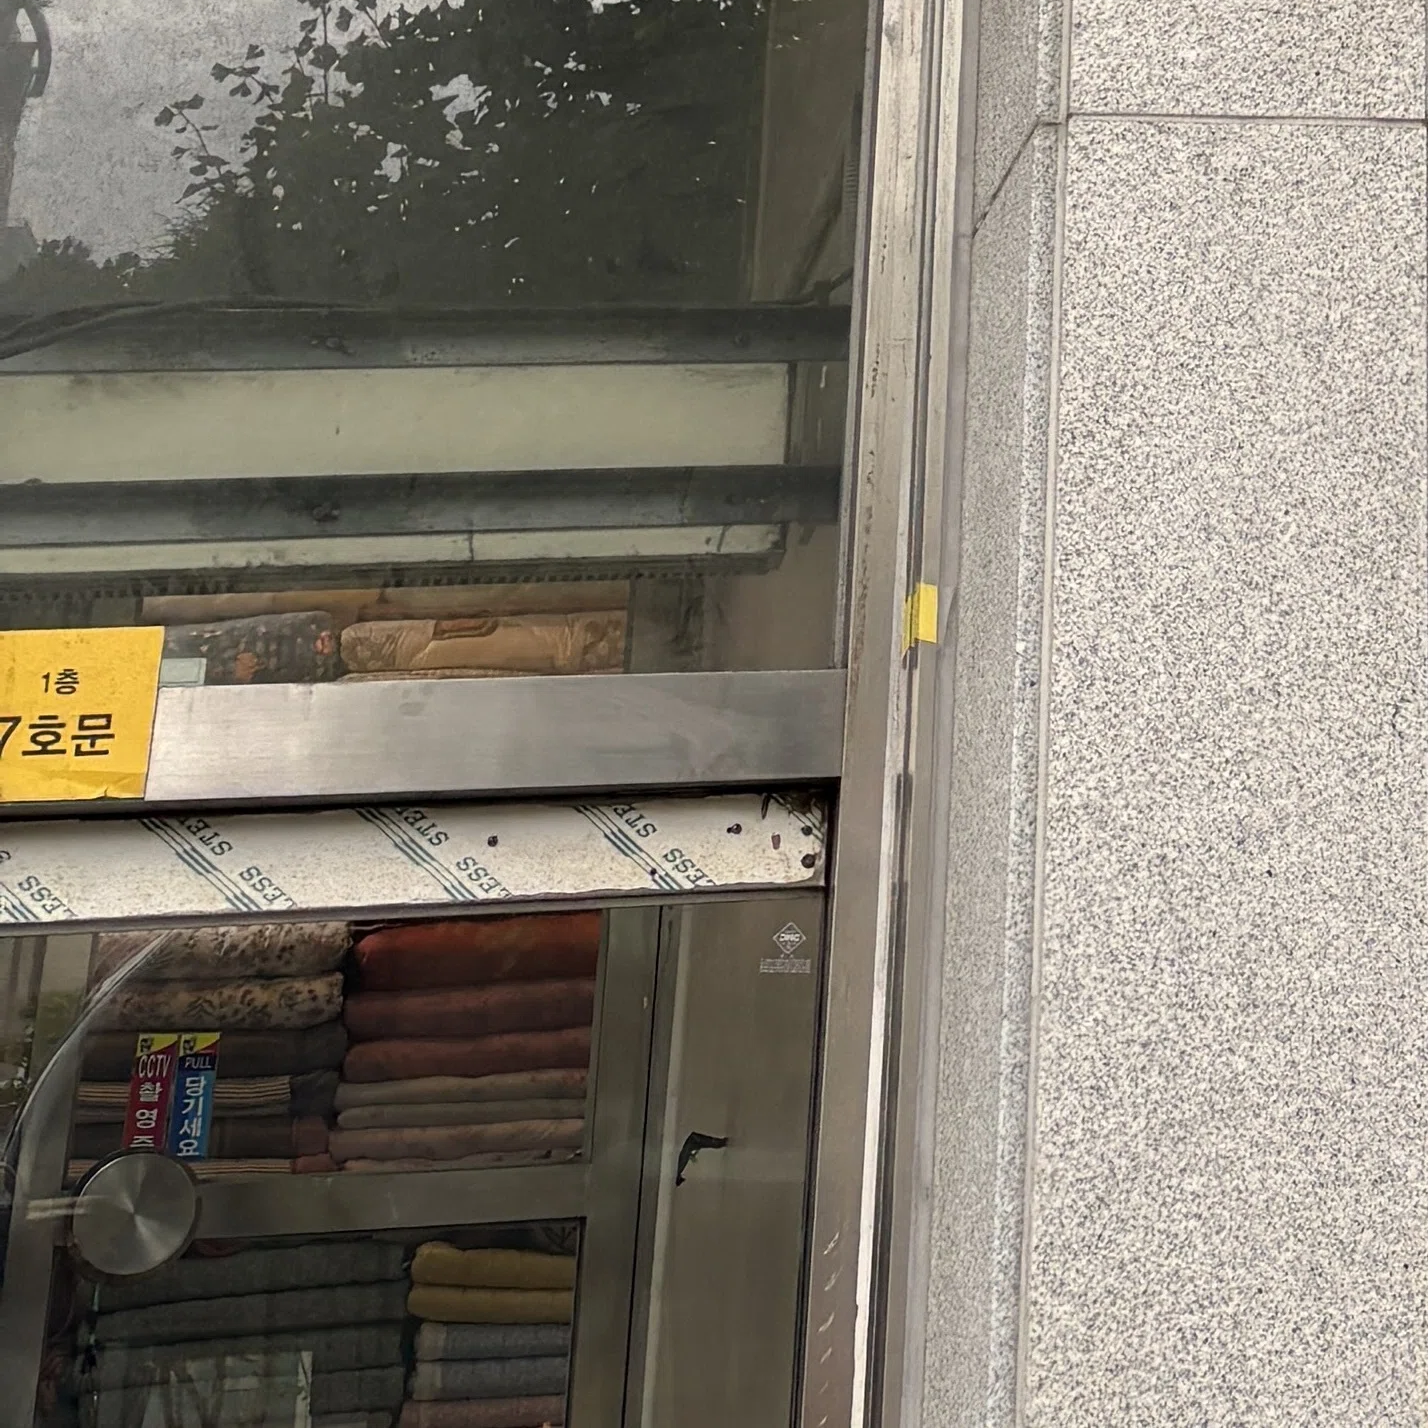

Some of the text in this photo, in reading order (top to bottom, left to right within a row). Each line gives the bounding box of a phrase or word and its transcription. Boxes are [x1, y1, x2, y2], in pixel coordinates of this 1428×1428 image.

[41, 668, 80, 695] 1층
[0, 713, 116, 760] 7호문
[138, 1054, 171, 1078] CCTV
[184, 1056, 212, 1070] PULL
[176, 1076, 206, 1157] 당기세요
